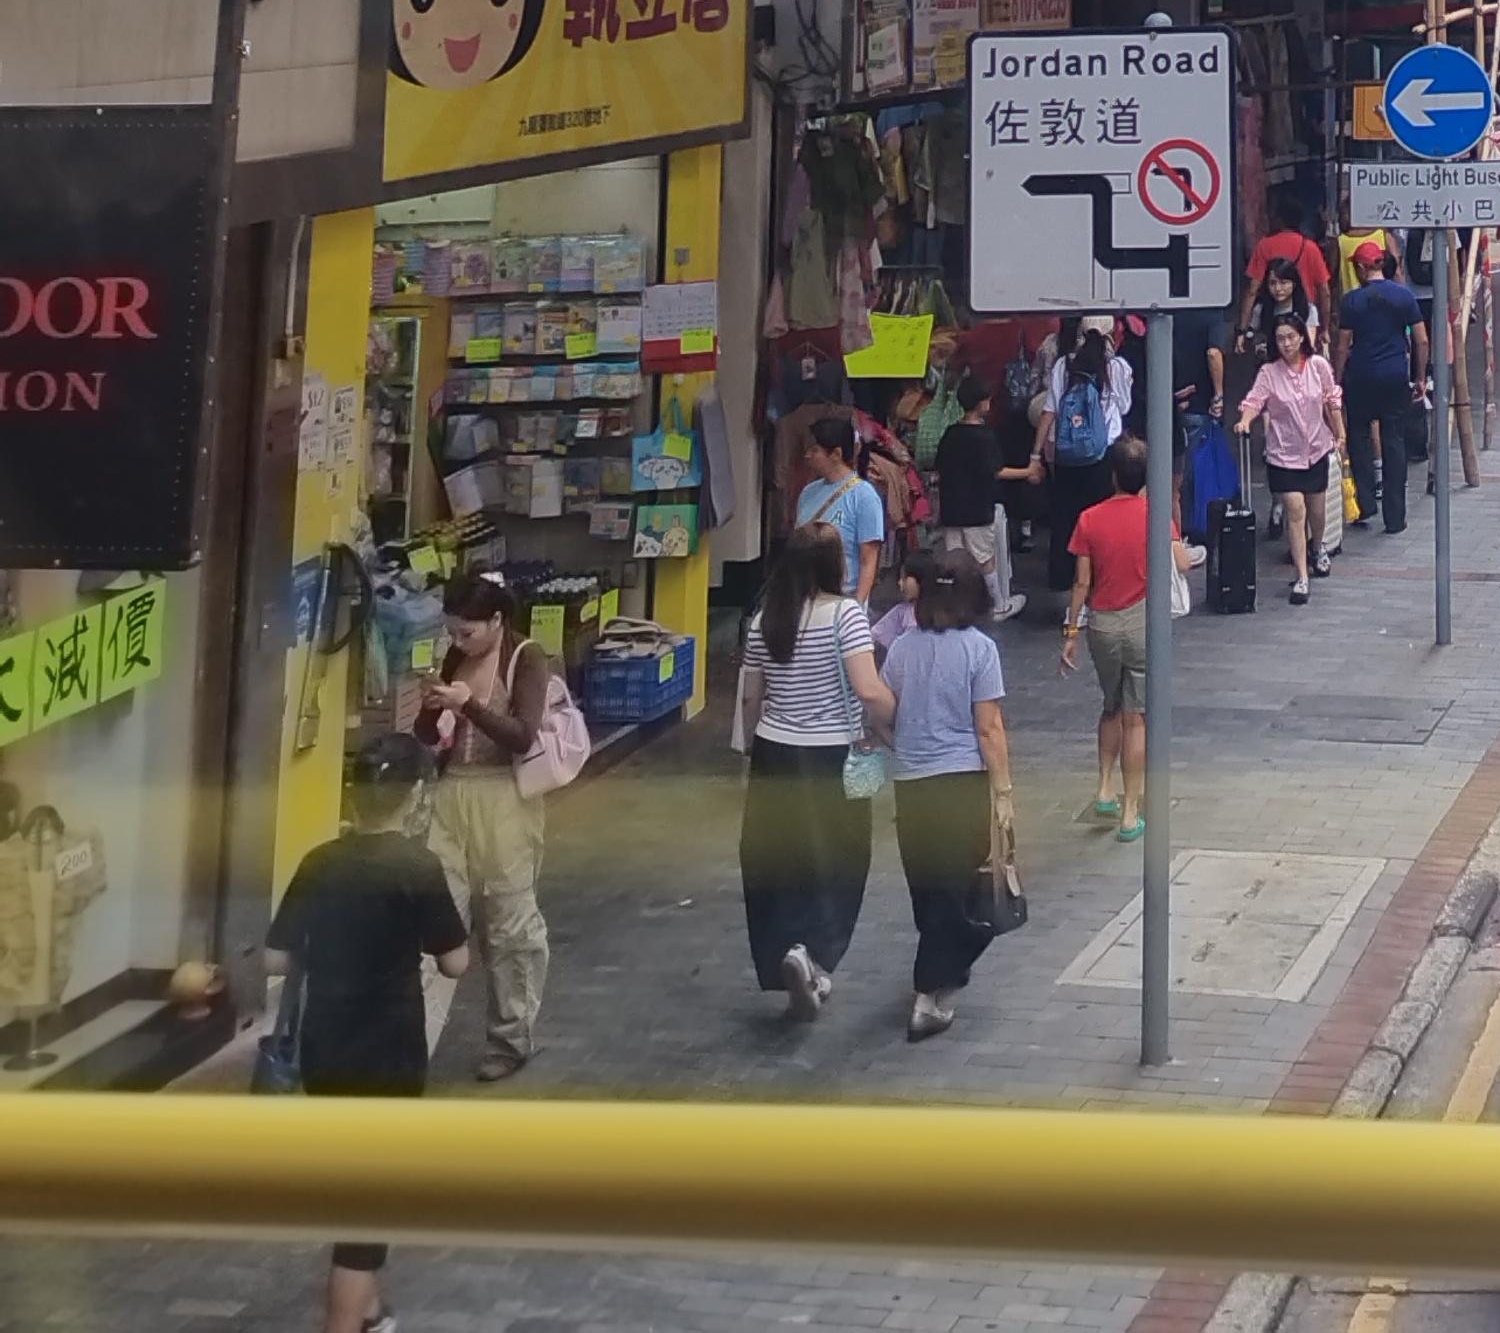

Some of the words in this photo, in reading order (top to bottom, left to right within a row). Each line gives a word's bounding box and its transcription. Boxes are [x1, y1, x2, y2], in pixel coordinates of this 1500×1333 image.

[983, 48, 1107, 79] Jordan
[1122, 44, 1219, 75] Road
[984, 96, 1142, 147] 佐敦道
[1356, 168, 1410, 186] Public
[1415, 167, 1459, 190] Light
[1377, 199, 1495, 221] 公共小巴
[58, 850, 89, 876] 200
